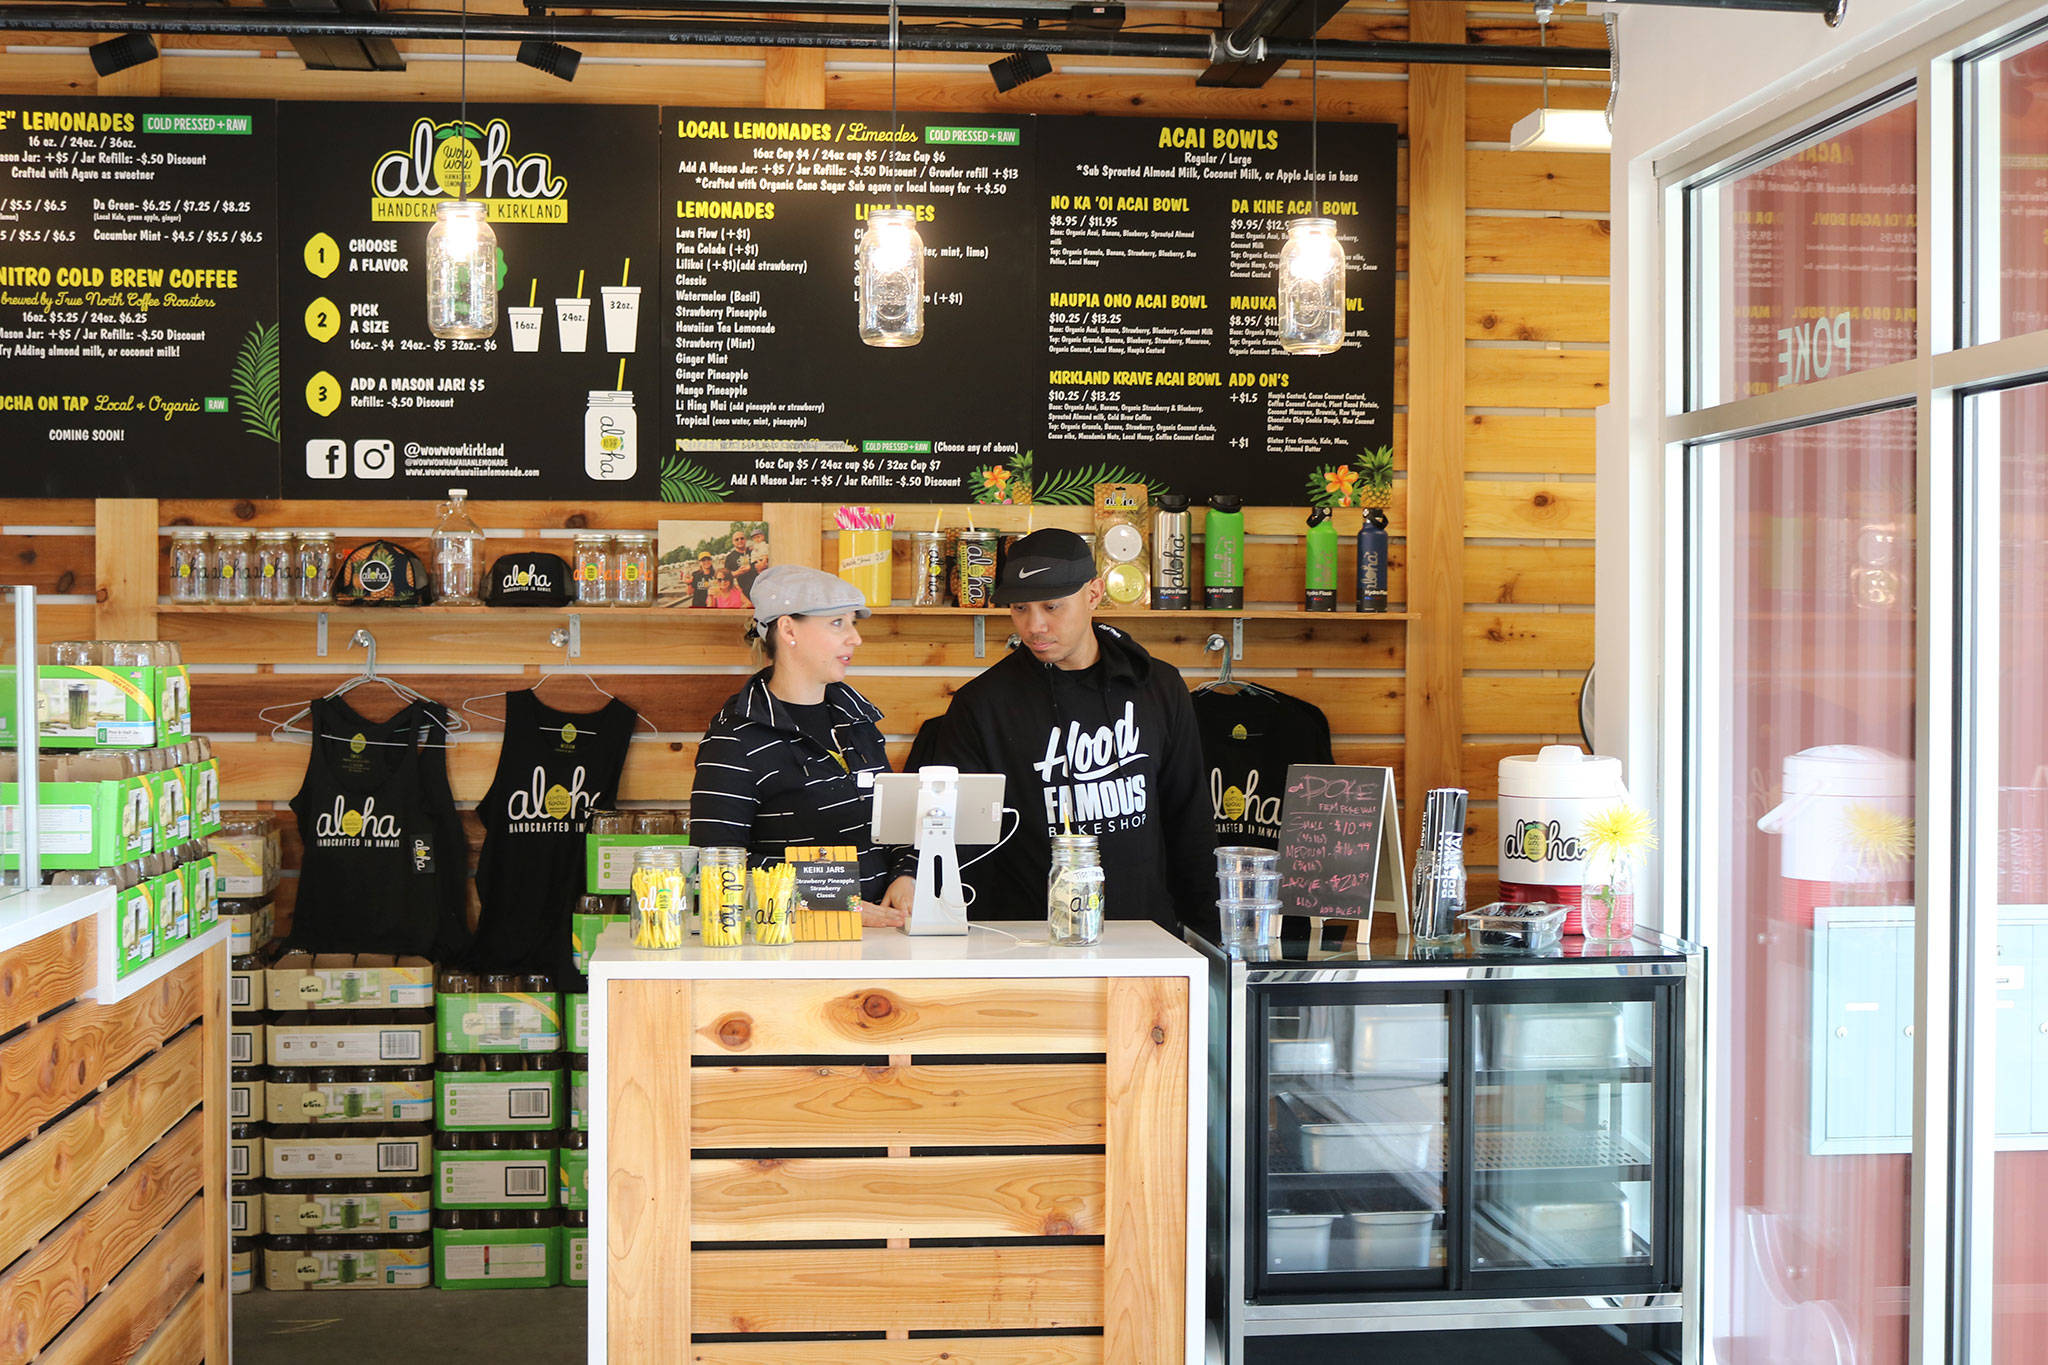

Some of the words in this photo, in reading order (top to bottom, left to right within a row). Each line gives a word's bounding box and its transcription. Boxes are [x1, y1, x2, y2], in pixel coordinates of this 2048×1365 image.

[23, 111, 134, 132] LEMONADES
[148, 117, 171, 130] COLD
[174, 118, 215, 130] PRESSED
[226, 119, 246, 131] RAW
[679, 121, 729, 139] LOCAL
[734, 122, 831, 141] LEMONADES
[835, 124, 845, 142] /
[847, 123, 918, 142] Limeades
[930, 130, 951, 141] COLD
[952, 130, 988, 141] PRESSED
[998, 132, 1015, 142] RAW
[1159, 127, 1205, 148] ACAI
[1213, 129, 1278, 150] BOWLS
[677, 201, 774, 219] LEMONADES
[1051, 195, 1069, 209] NO
[1074, 196, 1091, 210] KA
[1096, 196, 1112, 210] 'OI
[1117, 197, 1148, 211] ACAI
[1153, 198, 1189, 211] BOWL
[1232, 200, 1249, 213] DA
[1254, 200, 1283, 213] KINE
[1323, 202, 1358, 215] BOWL
[498, 204, 562, 219] KIRKLAND
[1050, 215, 1077, 226] $8.95
[1080, 215, 1086, 226] /
[1089, 216, 1117, 227] $11.95
[676, 227, 695, 238] Lava
[698, 227, 718, 238] Flow
[721, 228, 750, 241] (+$1)
[349, 239, 397, 252] CHOOSE
[318, 247, 326, 262] 1
[350, 259, 358, 271] A
[362, 259, 408, 272] FLAVOR
[57, 268, 104, 287] COLD
[111, 268, 163, 287] BREW
[170, 269, 237, 288] COFFEE
[676, 274, 706, 285] Classic
[1, 291, 39, 305] brewed
[40, 291, 52, 313] by
[55, 292, 82, 306] True
[86, 292, 124, 306] North
[127, 292, 160, 312] Coffee
[163, 293, 216, 308] Roasters
[676, 290, 726, 301] Watermelon
[730, 291, 760, 304] (Basil)
[1051, 292, 1099, 307] HAUPIA
[1104, 294, 1131, 307] ONO
[1136, 294, 1166, 308] ACAI
[1172, 295, 1207, 308] BOWL
[1231, 296, 1276, 310] MAUKA
[351, 304, 378, 316] PICK
[609, 300, 634, 310] 32oz.
[561, 312, 586, 322] 24oz.
[676, 305, 723, 320] Strawberry
[726, 306, 767, 320] Pineapple
[316, 312, 328, 328] 2
[350, 320, 359, 333] A
[362, 320, 389, 333] SIZE
[514, 320, 538, 330] 16oz.
[676, 321, 714, 332] Hawaiian
[717, 322, 731, 332] Tea
[735, 322, 775, 333] Lemonade
[351, 339, 378, 349] 16oz.-
[381, 339, 394, 351] $4
[401, 340, 430, 350] 24oz.-
[434, 340, 445, 351] $5
[452, 340, 481, 350] 32oz.-
[484, 341, 497, 351] $6
[676, 353, 705, 366] Ginger
[708, 354, 728, 364] Mint
[351, 378, 375, 391] ADD
[379, 378, 387, 391] A
[392, 378, 434, 391] MASON
[437, 379, 465, 391] JAR!
[470, 379, 484, 392] $5
[1050, 371, 1110, 385] KIRKLAND
[1114, 372, 1153, 385] KRAVE
[1155, 372, 1184, 386] ACAI
[1188, 373, 1222, 386] BOWL
[1229, 373, 1255, 387] ADD
[1259, 373, 1289, 387] ON'S
[318, 386, 328, 402] 3
[676, 384, 703, 398] Mango
[707, 384, 747, 398] Pineapple
[1230, 392, 1257, 403] +$1.5
[38, 396, 58, 410] ON
[62, 396, 88, 411] TAP
[94, 395, 134, 412] Local
[148, 395, 200, 422] Organic
[209, 400, 224, 409] RAW
[351, 396, 383, 407] Refills:
[387, 396, 413, 408] -$.50
[417, 397, 454, 407] Discount
[49, 429, 89, 440] COMING
[92, 430, 124, 441] SOON!
[1229, 437, 1248, 448] +$1
[404, 442, 504, 458] @wowwowkirkland
[405, 466, 540, 478] www.wowwowhawaiianlemonade.com
[502, 564, 552, 588] aloha
[966, 545, 993, 605] aloha
[1033, 700, 1140, 782] Hood
[1043, 774, 1147, 824] FAMOUS
[316, 794, 401, 838] aloha
[508, 822, 570, 833] HANDCRAFTED
